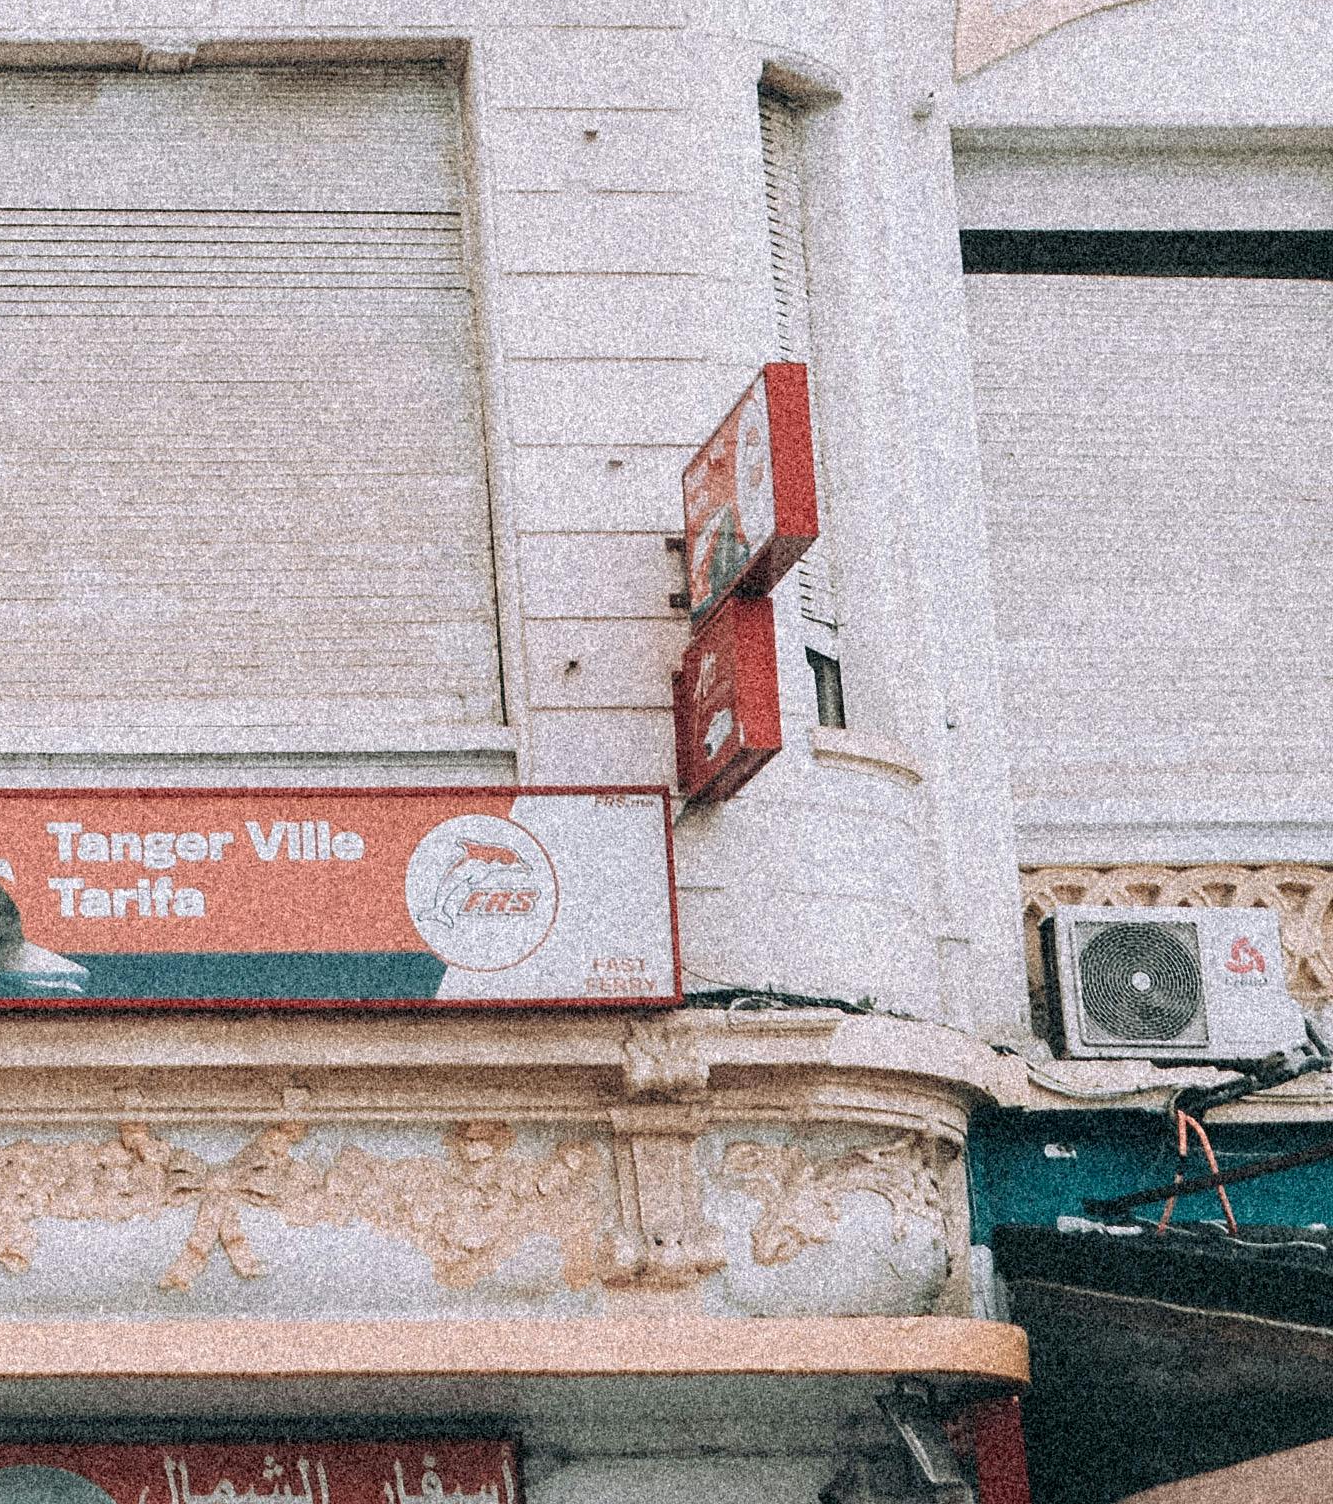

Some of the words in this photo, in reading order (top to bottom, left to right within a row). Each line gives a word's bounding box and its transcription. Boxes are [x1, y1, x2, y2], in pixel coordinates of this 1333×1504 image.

[47, 821, 234, 870] Tanger
[245, 819, 365, 861] Ville
[48, 876, 206, 918] Tarifa
[464, 889, 538, 914] FRS
